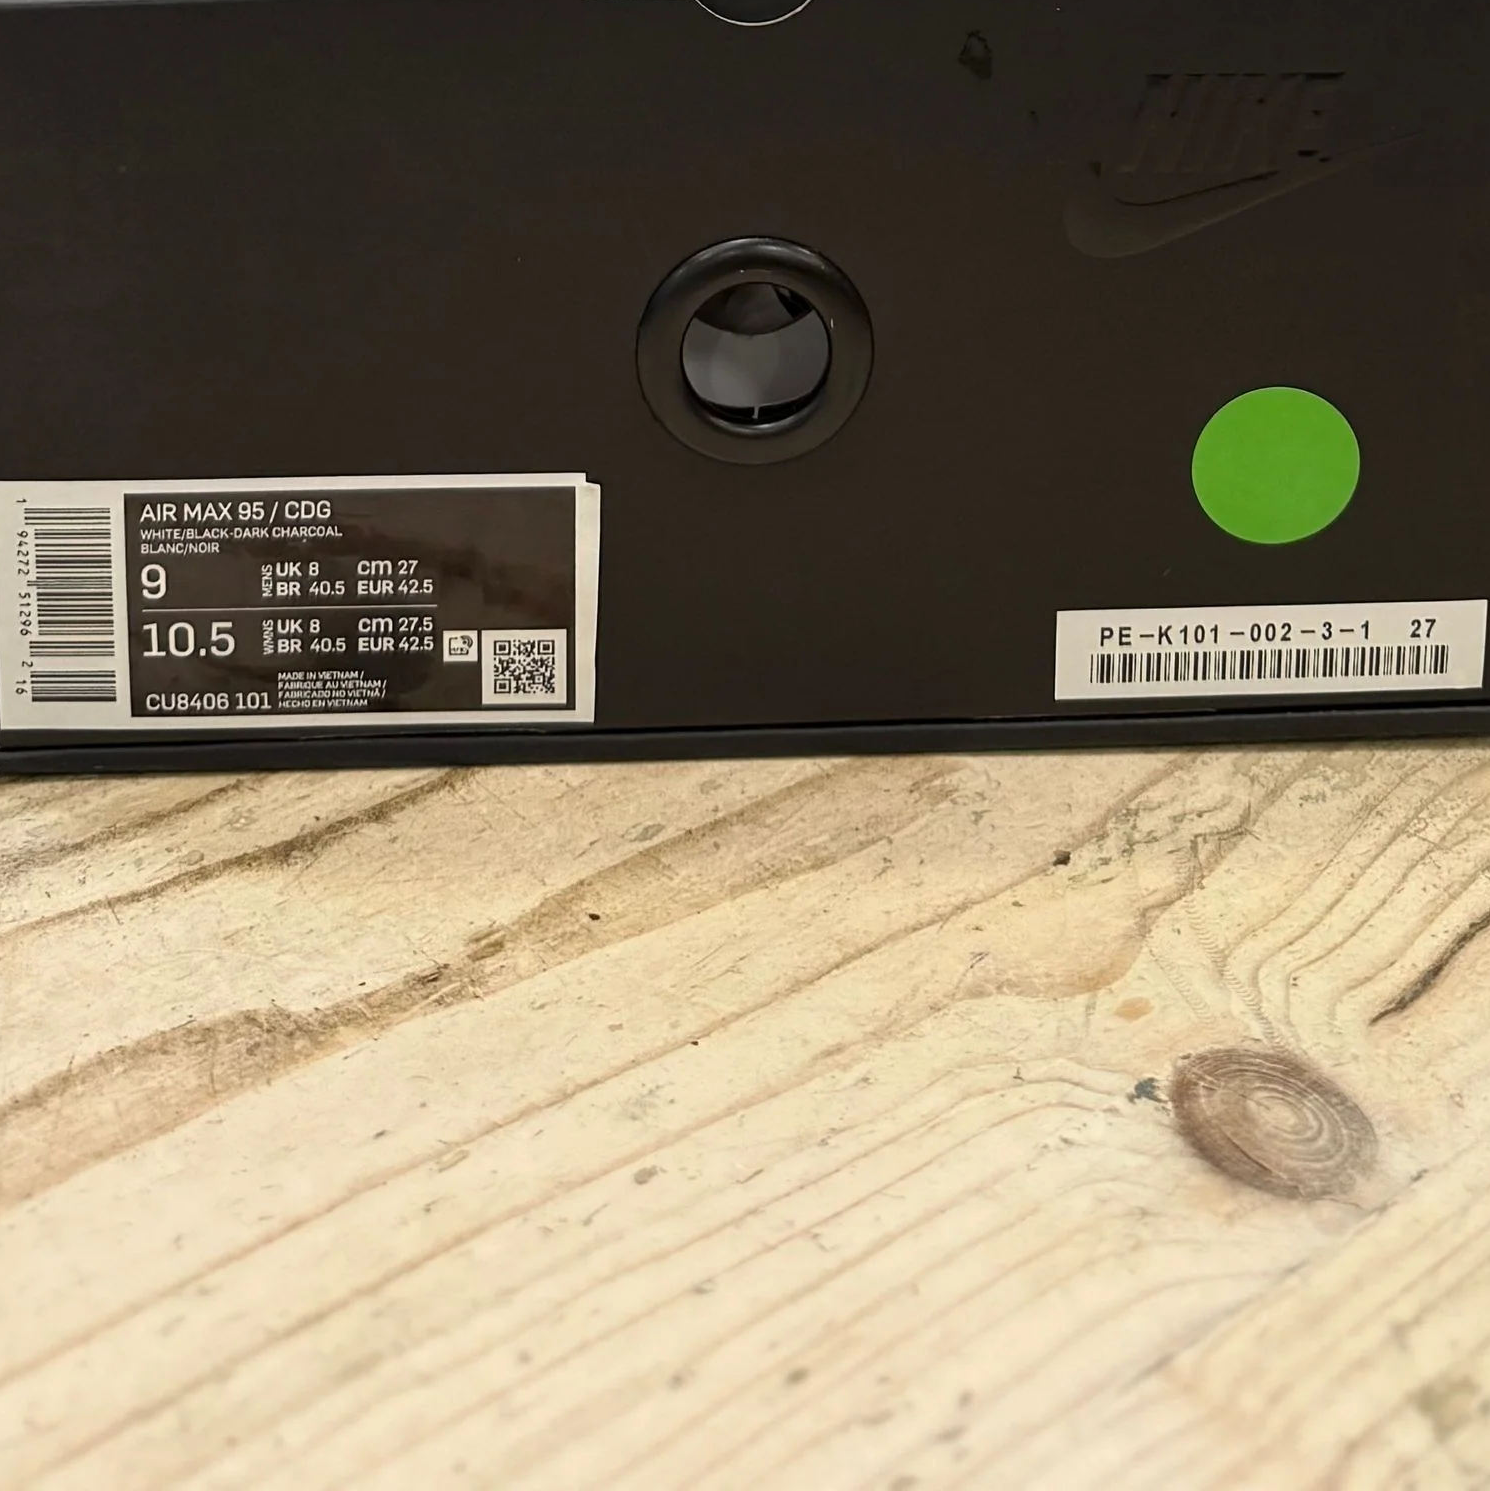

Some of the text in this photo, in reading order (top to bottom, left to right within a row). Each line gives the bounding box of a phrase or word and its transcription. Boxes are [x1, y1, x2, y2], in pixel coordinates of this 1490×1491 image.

[140, 503, 177, 522] AIR
[183, 502, 233, 522] MAX
[238, 501, 265, 520] 95
[284, 500, 331, 519] CDG
[140, 526, 343, 541] WHITE/BLACK-DARK CHARCOAL
[16, 530, 30, 576] 94272
[140, 542, 220, 555] BLANC/NOIR
[276, 560, 418, 577] UK 8 cm 27
[141, 563, 167, 599] 9
[262, 564, 273, 597] MENS
[276, 579, 433, 596] BR 40.5 EUR 42.5
[18, 592, 32, 637] 51296
[277, 617, 433, 633] UK 8 cm 27.5
[1409, 618, 1437, 639] 27
[142, 621, 235, 657] 10.5
[263, 619, 274, 655] WMNS
[277, 636, 434, 653] BR 40.5 EUR 42.5
[21, 660, 34, 668] 2
[278, 671, 304, 680] MADE
[306, 671, 317, 680] IN
[318, 671, 359, 680] VIETNAM
[15, 679, 28, 695] 16
[146, 691, 272, 711] CU8406 101
[327, 698, 368, 707] VIETNAM
